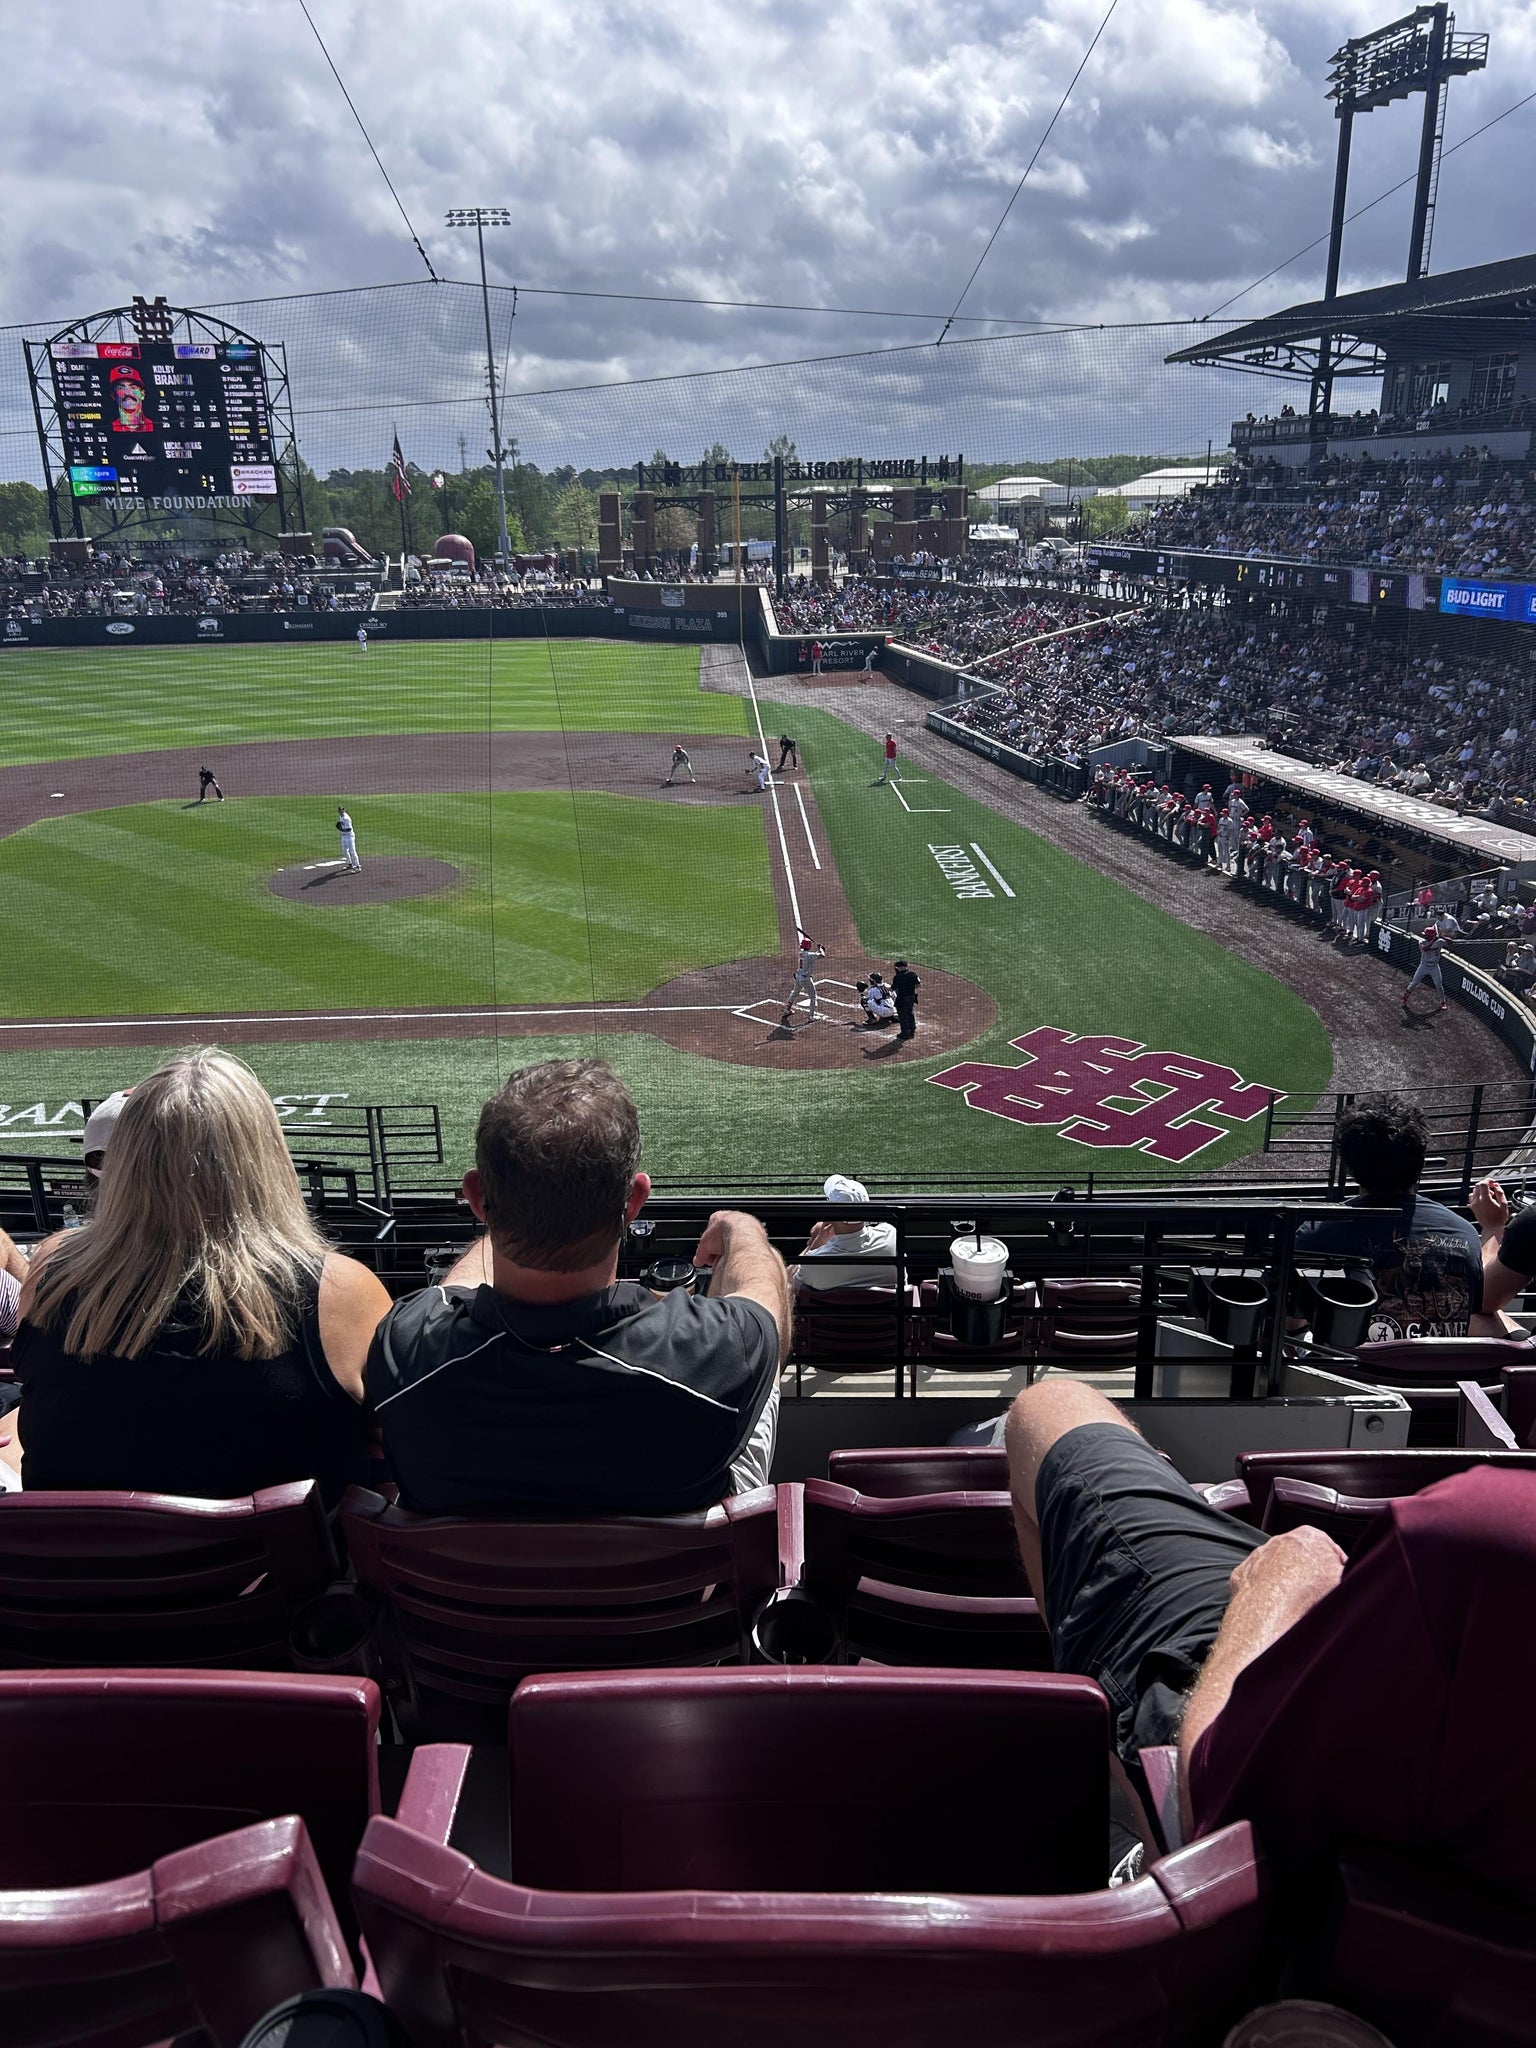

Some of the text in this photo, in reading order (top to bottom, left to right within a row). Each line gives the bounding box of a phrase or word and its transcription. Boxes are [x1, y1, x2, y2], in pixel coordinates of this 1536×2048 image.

[105, 495, 251, 510] MIZE FOUNDATION
[1259, 569, 1303, 587] R H E
[1324, 573, 1338, 583] BALL
[1379, 578, 1393, 589] OUT
[1447, 589, 1505, 608] BUD LIGHT
[675, 617, 713, 631] PLAZA
[841, 649, 864, 657] RIVER
[823, 657, 854, 665] RESORT
[927, 843, 995, 899] BANKFIRST
[1461, 976, 1506, 1020] BULLDOG CLUB
